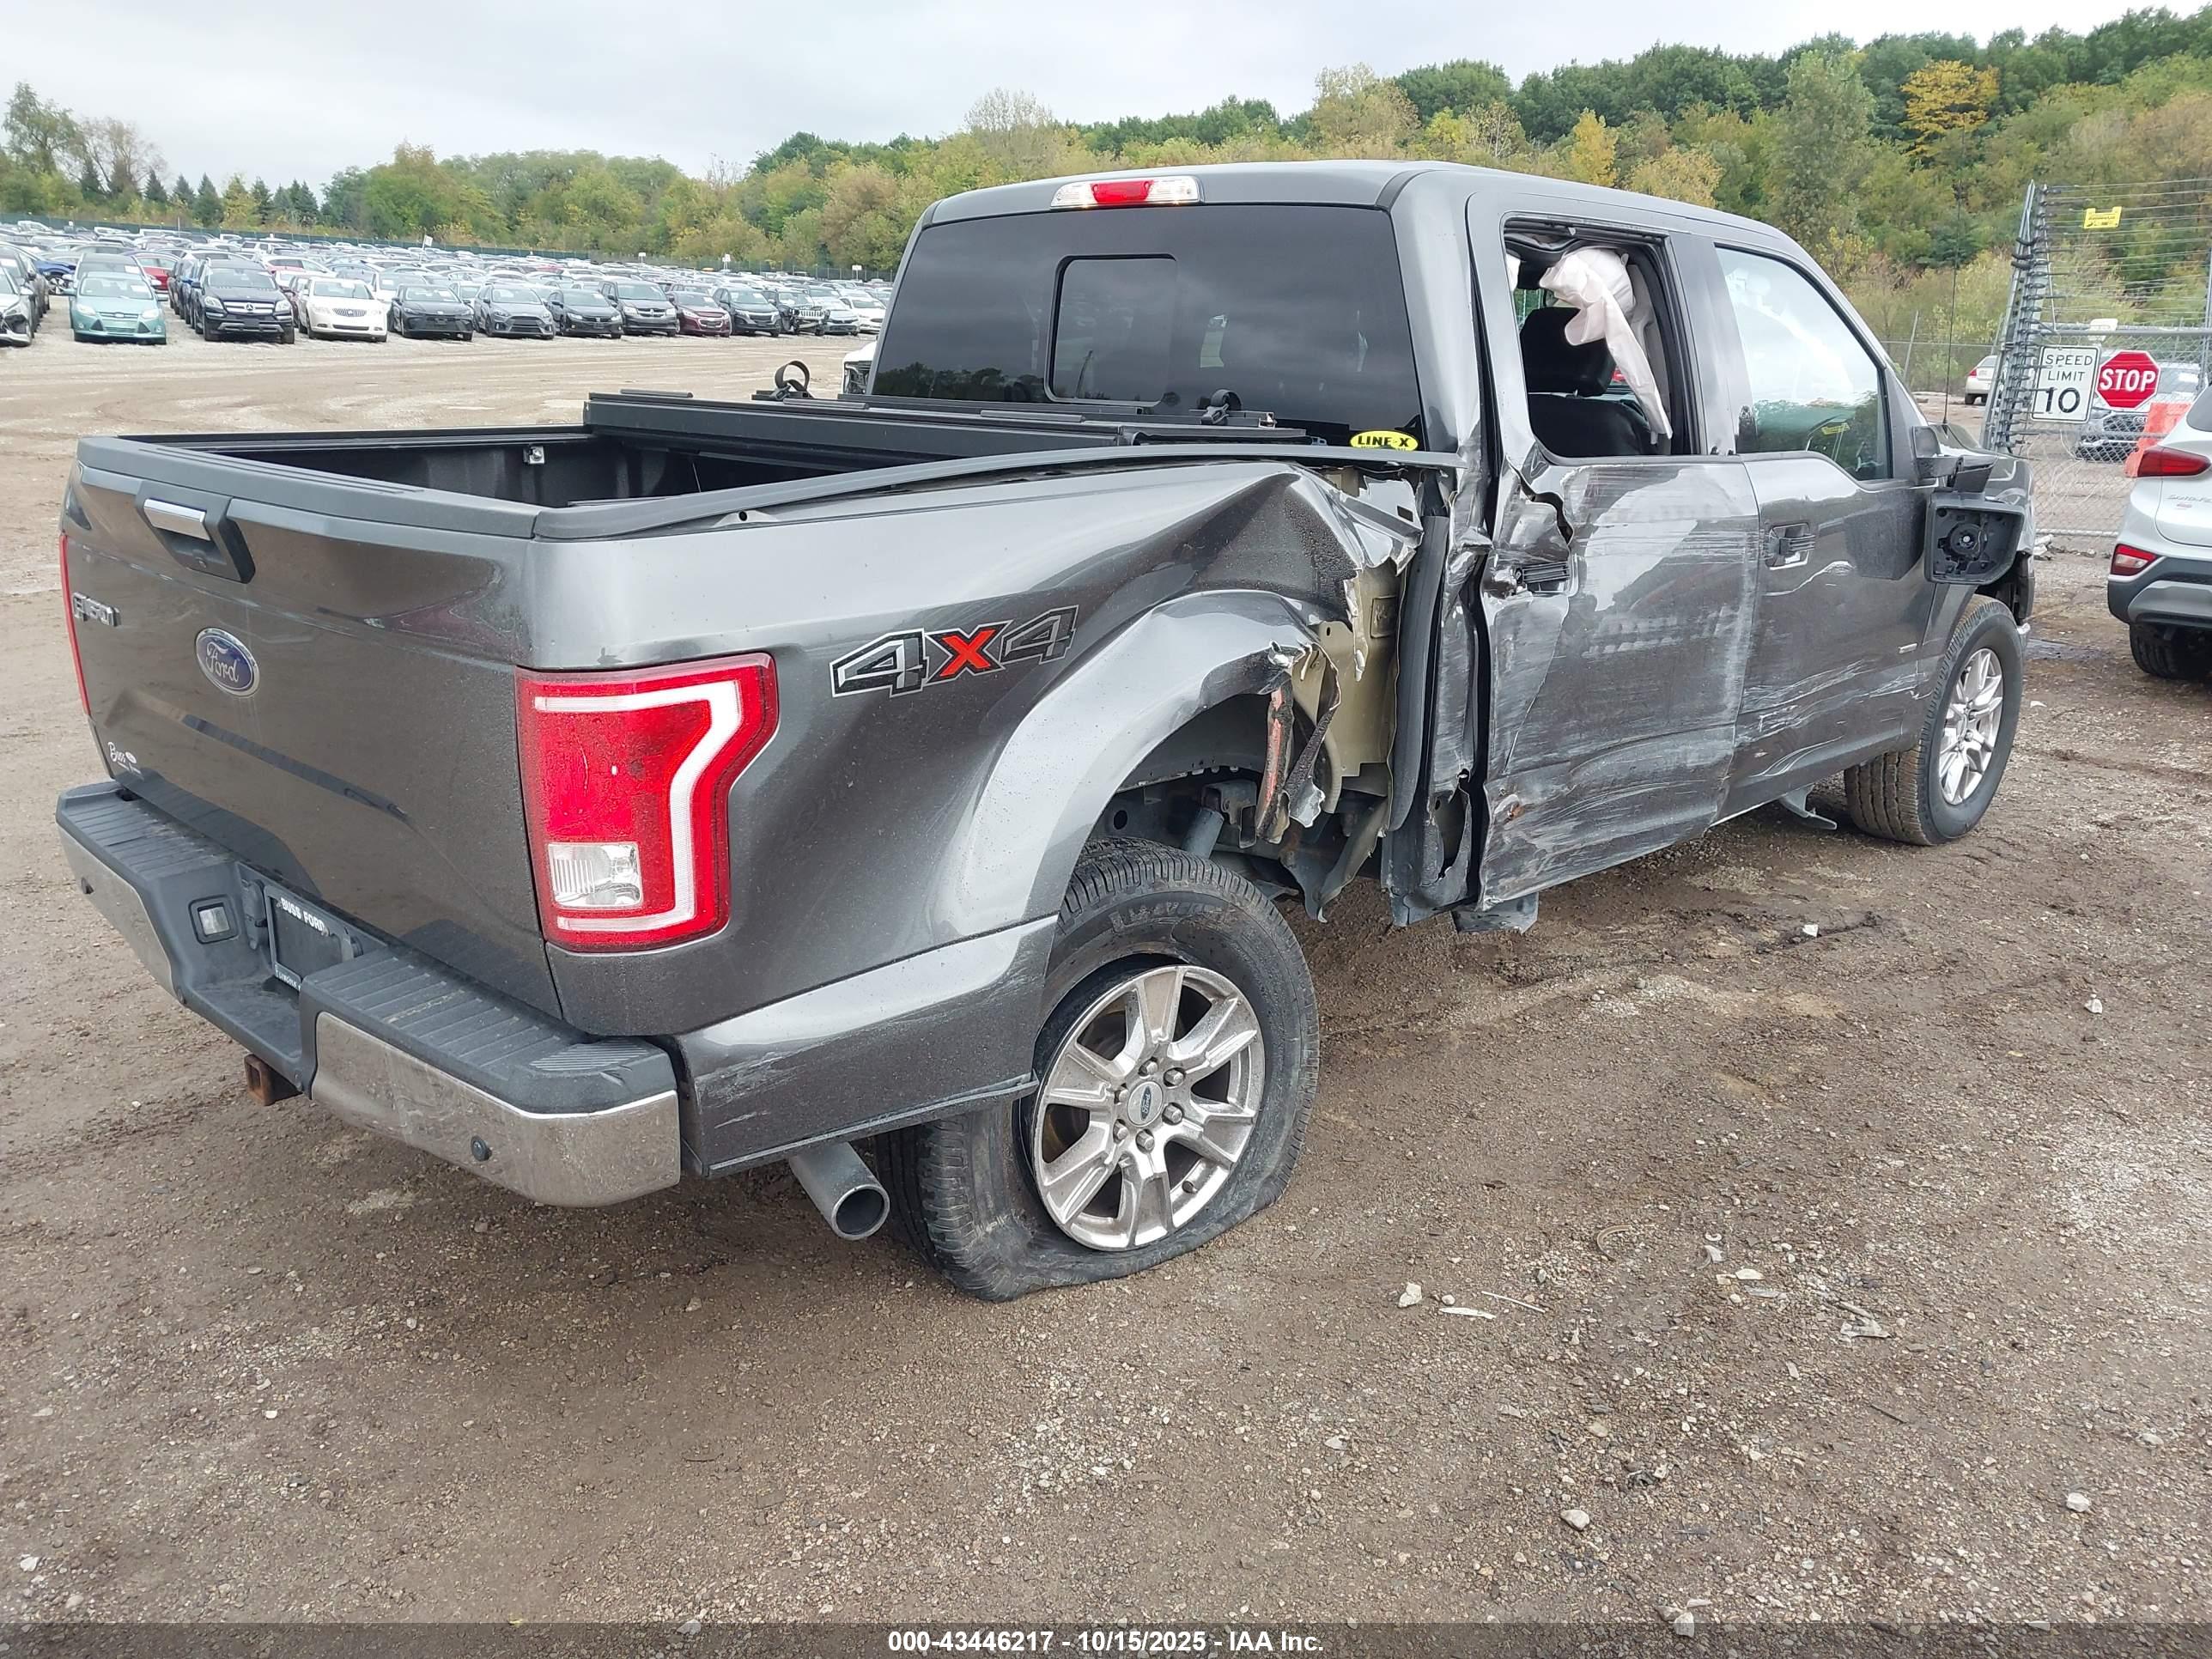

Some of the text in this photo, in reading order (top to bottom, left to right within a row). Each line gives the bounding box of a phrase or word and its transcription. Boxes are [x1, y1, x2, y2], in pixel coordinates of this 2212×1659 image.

[2045, 354, 2093, 366] SPEED
[2047, 370, 2086, 381] LIMIT
[2099, 368, 2156, 392] STOP
[2045, 386, 2081, 414] 10
[206, 641, 240, 683] Ford
[280, 896, 325, 932] BUSS FORD
